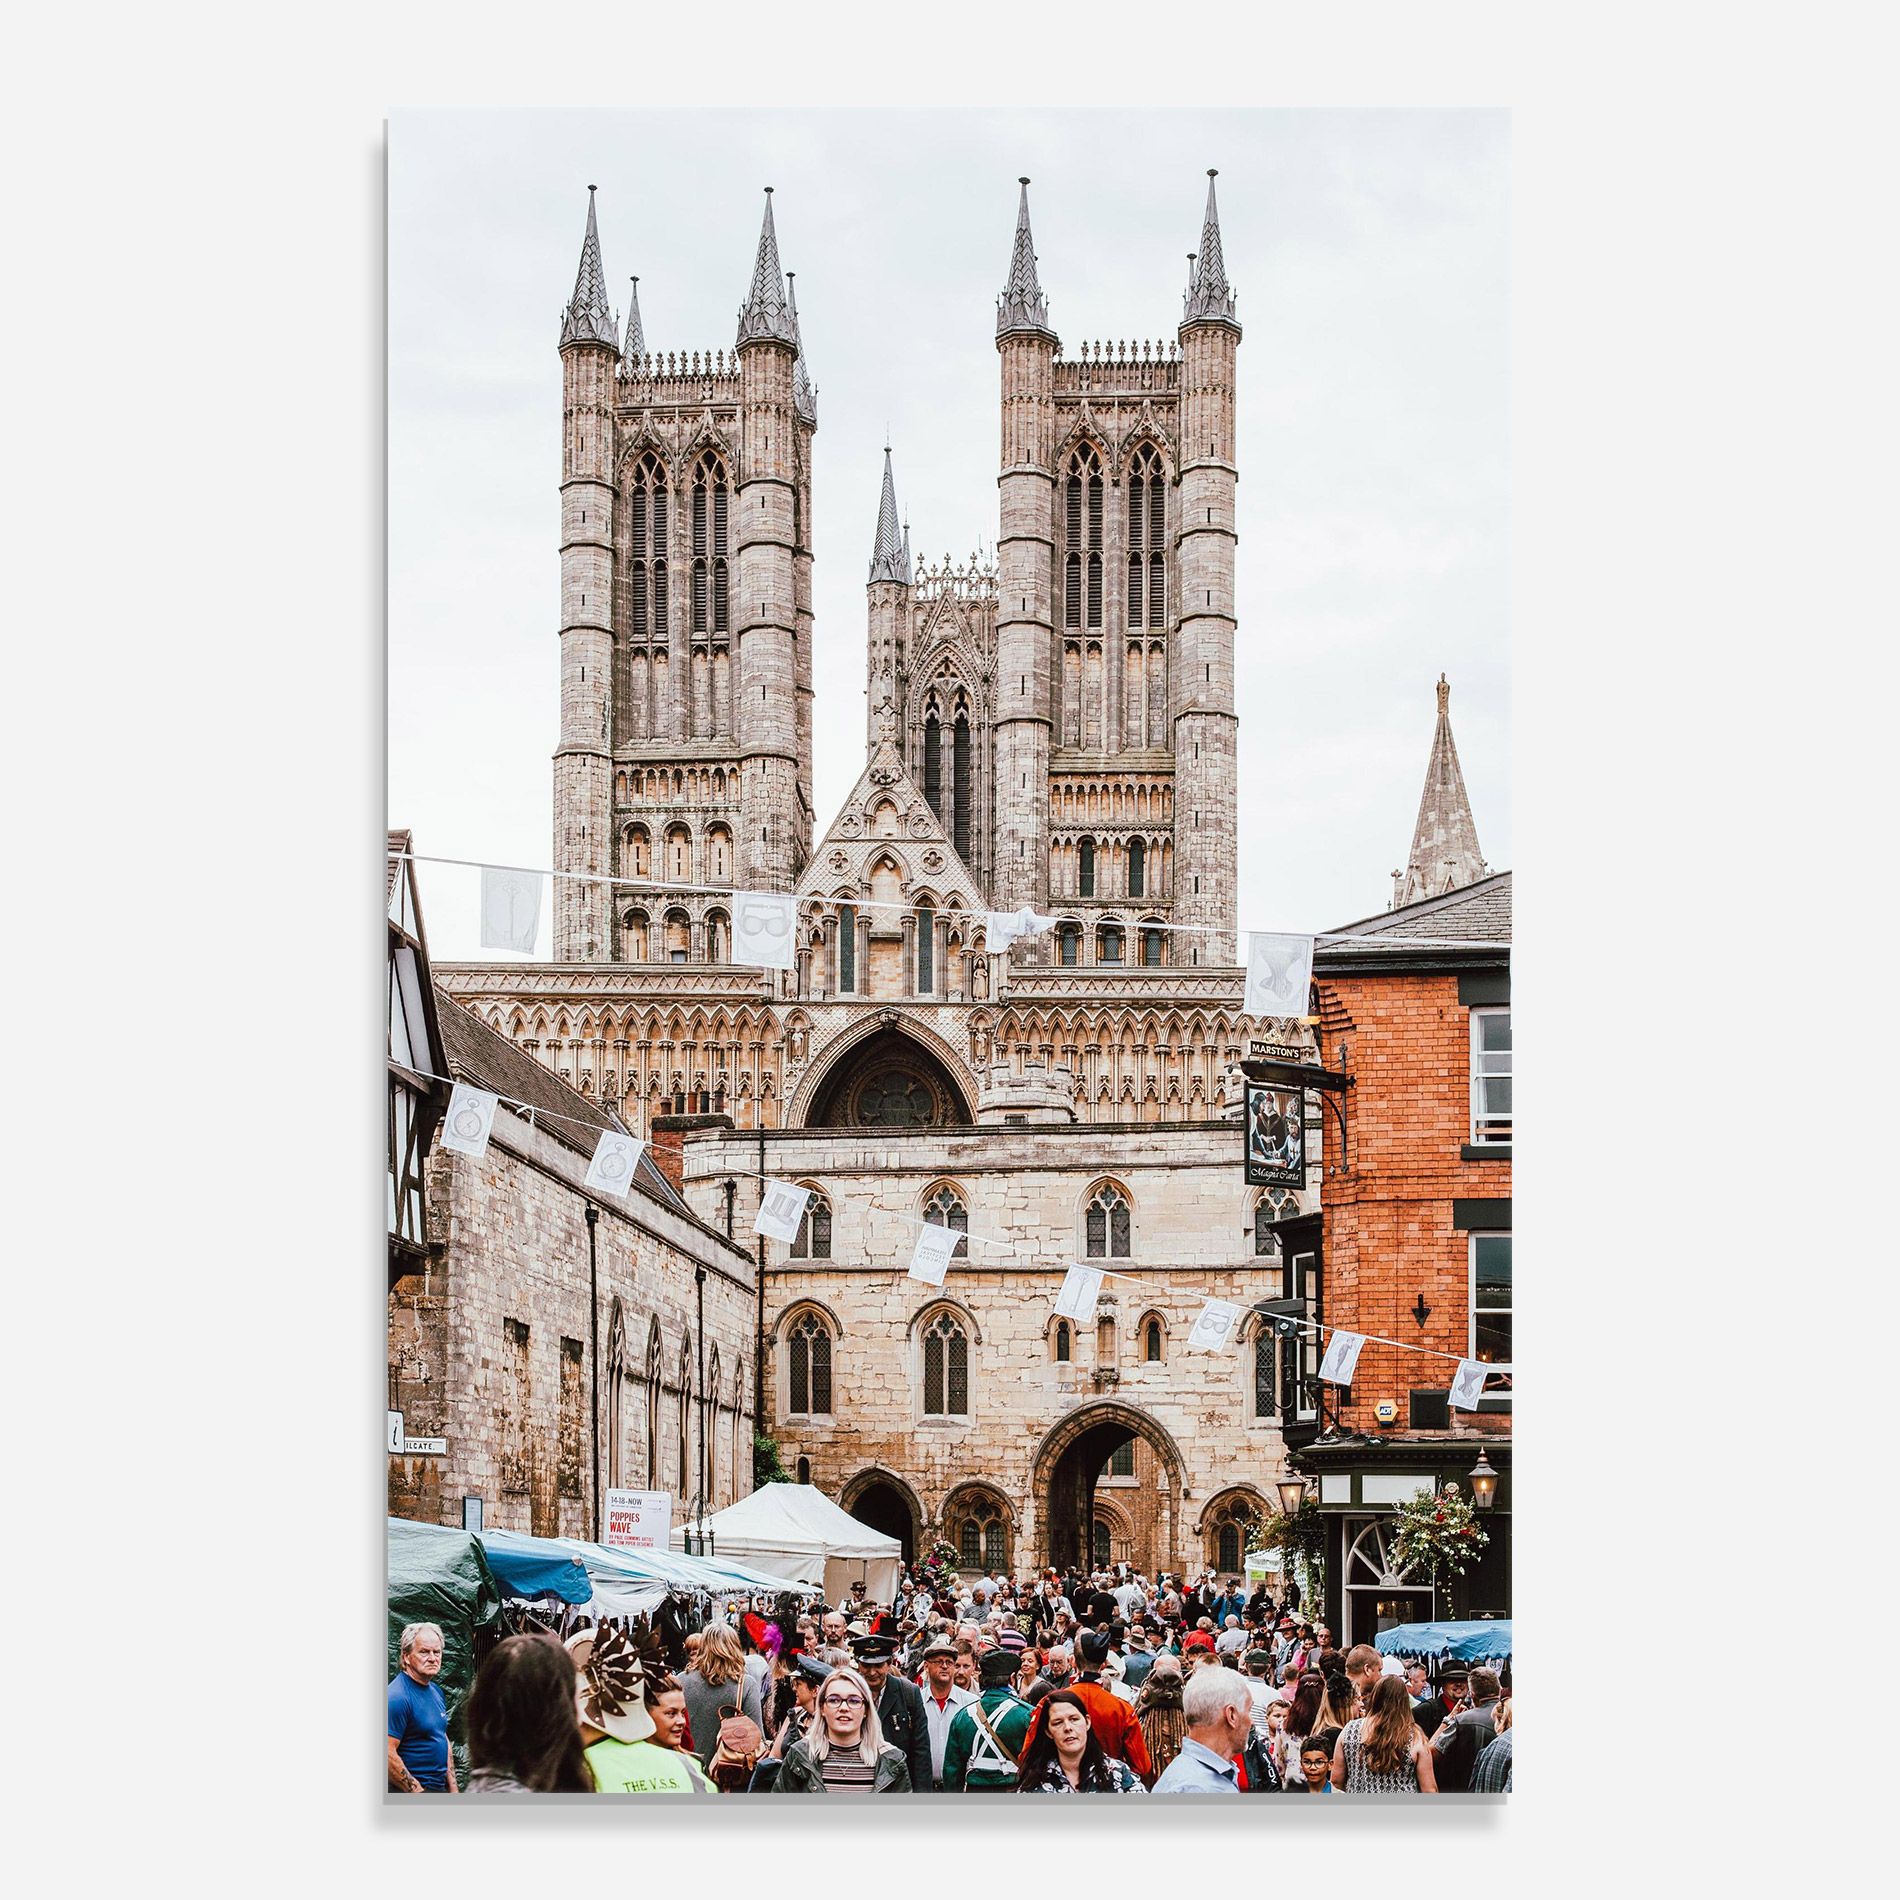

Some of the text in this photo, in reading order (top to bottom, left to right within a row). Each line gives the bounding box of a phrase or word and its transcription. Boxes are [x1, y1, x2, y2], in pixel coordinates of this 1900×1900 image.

[1252, 1043, 1299, 1058] MARSTON'S
[1251, 1168, 1299, 1180] Magna Carta
[610, 1511, 640, 1523] POPPIES
[610, 1522, 631, 1533] WAVE
[623, 1780, 647, 1792] THE
